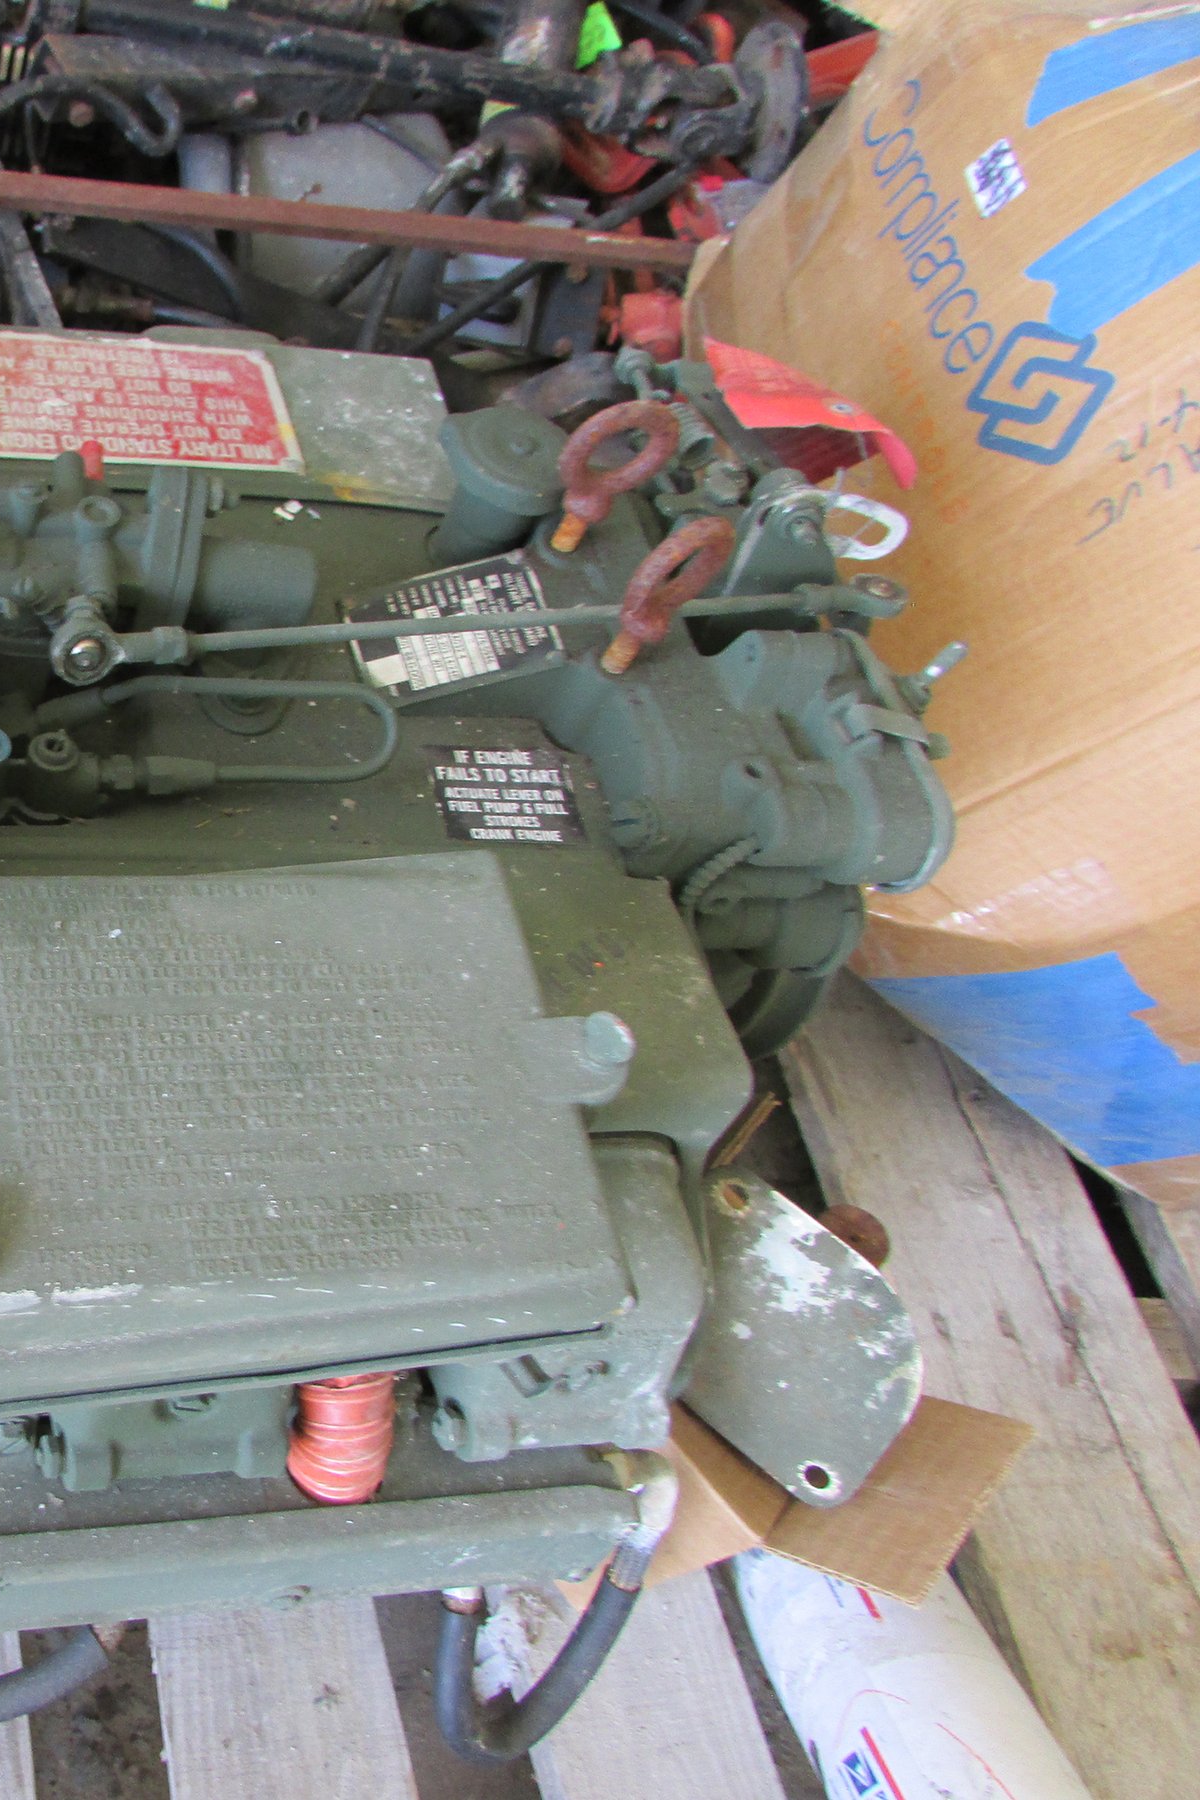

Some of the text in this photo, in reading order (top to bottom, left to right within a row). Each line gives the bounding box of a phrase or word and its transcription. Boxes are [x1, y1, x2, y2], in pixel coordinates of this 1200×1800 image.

[864, 79, 994, 375] Compliance
[24, 358, 47, 371] OF
[54, 359, 105, 375] FLOW
[113, 362, 160, 379] FREE
[165, 366, 234, 384] WHERE
[32, 373, 192, 395] DO NOT OPERATE
[61, 388, 95, 403] AIR
[103, 391, 121, 405] IS
[128, 392, 197, 409] ENGINE
[205, 396, 247, 412] THIS
[85, 405, 195, 423] SHROUDING
[204, 411, 253, 426] WITH
[0, 415, 242, 440] DO NOT OPERATE ENGINE
[62, 433, 172, 454] STANDD
[178, 440, 272, 460] MILITARY
[452, 750, 533, 765] IF ENGINE
[434, 766, 481, 781] FAILS
[482, 768, 507, 782] TO
[444, 787, 565, 801] ACTUATE LEVER ON
[447, 800, 568, 815] FUEL PUMP 6 FULL
[483, 815, 540, 827] STROKES
[469, 828, 563, 842] CRANK ENGINE
